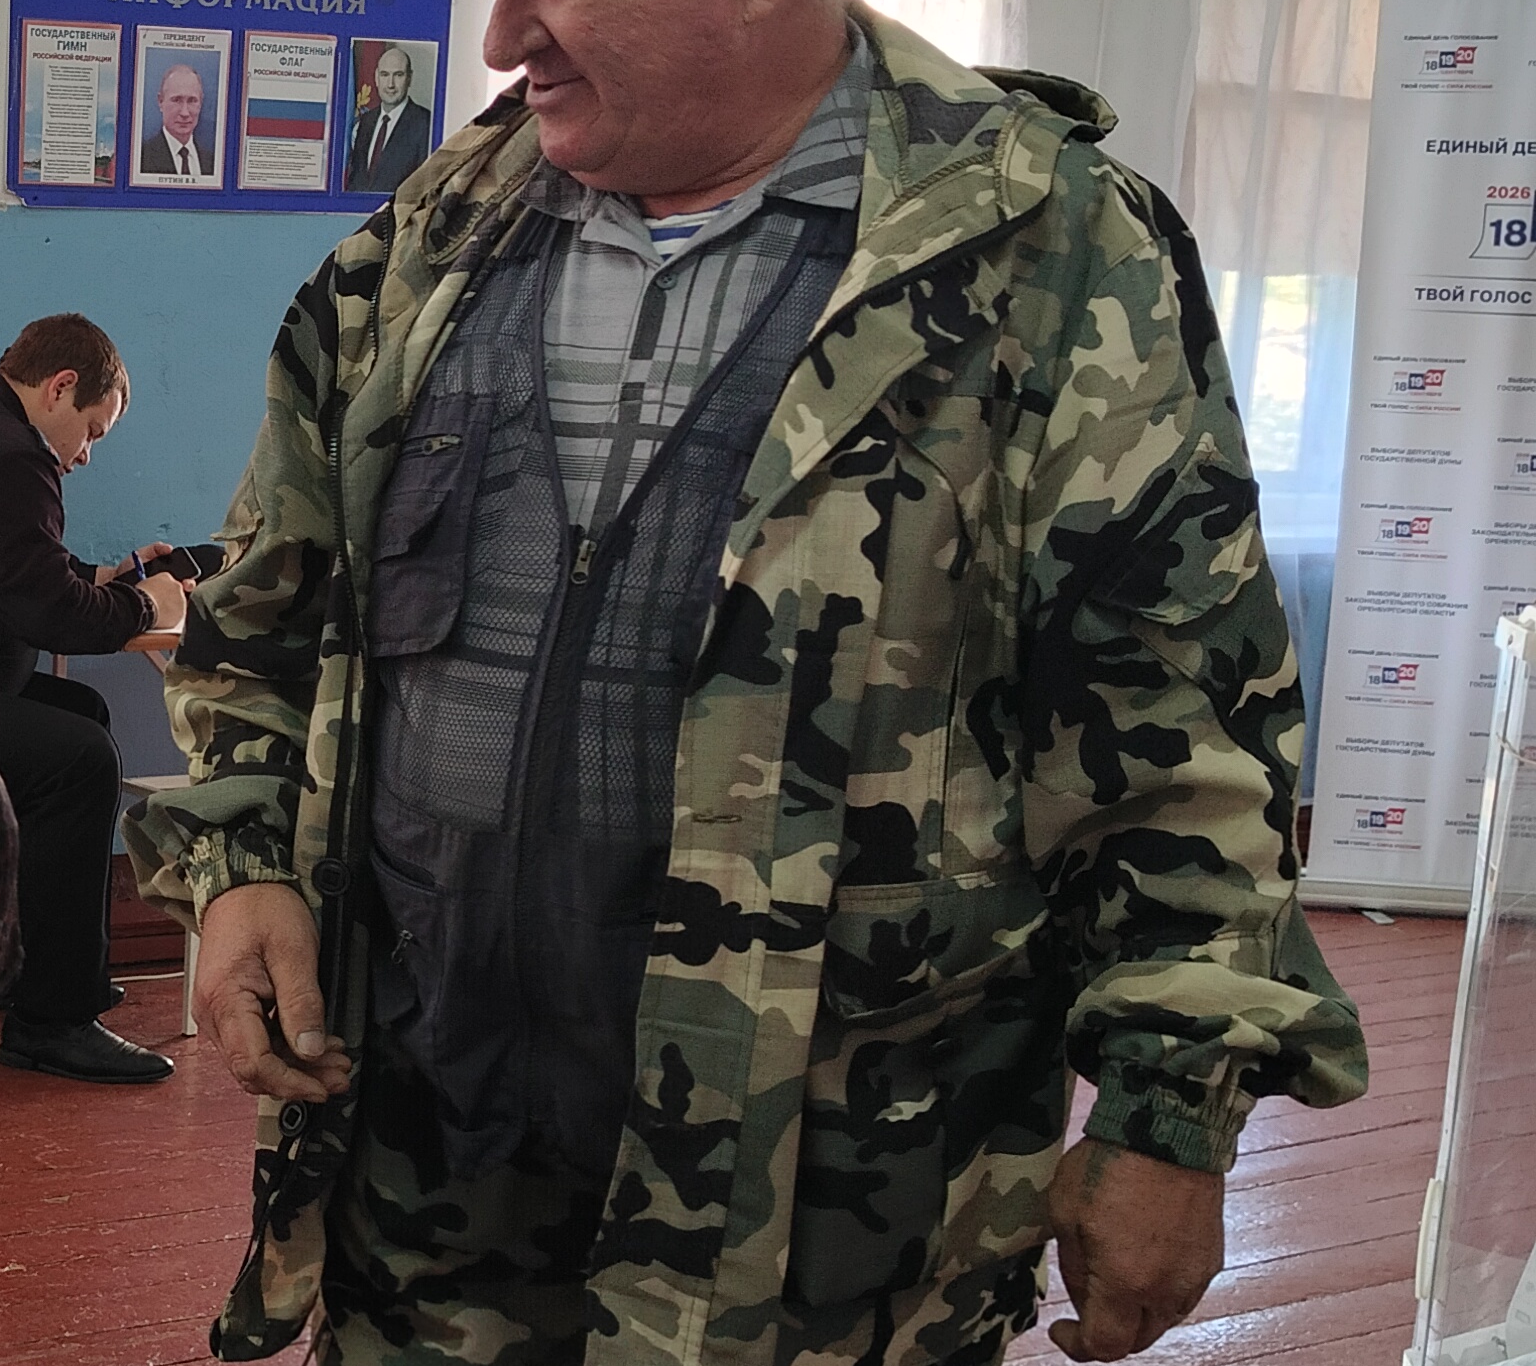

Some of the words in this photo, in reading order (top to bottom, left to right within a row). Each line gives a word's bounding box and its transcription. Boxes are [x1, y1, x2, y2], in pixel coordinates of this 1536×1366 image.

[30, 27, 116, 41] ГОСУДАРСТВЕННЫЙ
[163, 33, 205, 42] ПРЕЗИДЕНТ
[57, 40, 87, 52] ГИМН
[250, 42, 333, 57] ГОСУДАРСТВЕННЫЙ
[32, 52, 74, 62] РОССИЙСКОЙ
[75, 55, 112, 64] ФЕДЕРАЦИИ
[1440, 54, 1454, 66] 19
[1456, 49, 1473, 61] 20
[279, 56, 305, 67] ФЛАГ
[1425, 61, 1438, 71] 18
[253, 68, 292, 77] РОССИЙСКОЙ
[293, 70, 327, 79] ФЕДЕРАЦИИ
[1425, 137, 1508, 155] ЕДИНЫЙ
[158, 176, 183, 184] ПУТИН
[1486, 186, 1531, 199] 2026
[1489, 218, 1527, 247] 18
[1414, 285, 1464, 302] ТВОЙ
[1469, 289, 1532, 304] ГОЛОС
[1410, 377, 1424, 387] 19
[1426, 373, 1442, 383] 20
[1394, 381, 1407, 391] 18
[1370, 447, 1406, 455] ВЫБОРЫ
[1406, 449, 1452, 457] ДЕПУТАТОВ
[1360, 455, 1436, 465] ГОСУДАРСТВЕННОЙ
[1516, 463, 1529, 474] 18
[1396, 525, 1410, 535] 19
[1412, 521, 1428, 531] 20
[1381, 529, 1394, 539] 18
[1366, 589, 1401, 598] ВЫБОРЫ
[1402, 591, 1447, 601] ДЕПУТАТОВ
[1384, 671, 1396, 681] 19
[1399, 667, 1414, 677] 20
[1368, 675, 1380, 685] 18
[1346, 737, 1379, 745] ВЫБОРЫ
[1380, 739, 1424, 747] ДЕПУТАТОВ
[1372, 815, 1384, 825] 19
[1386, 811, 1402, 822] 20
[1356, 819, 1368, 829] 18
